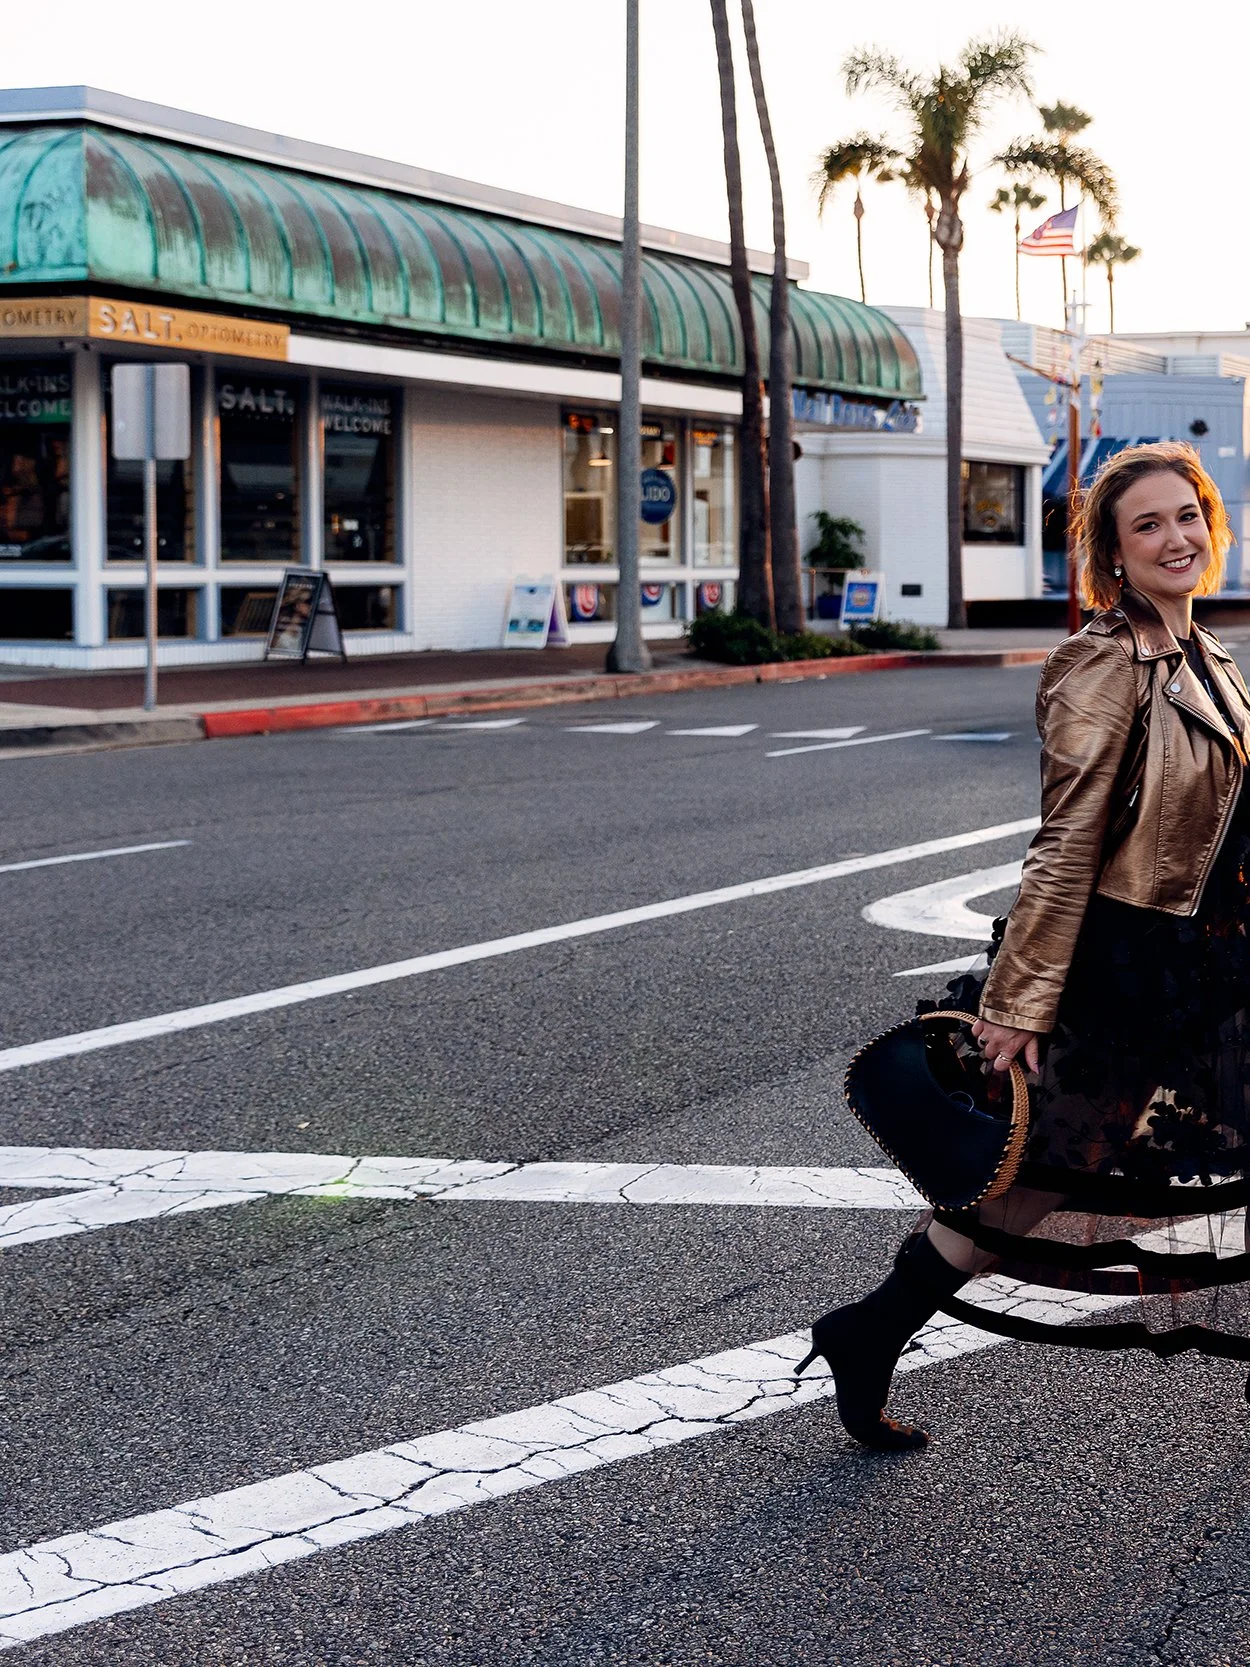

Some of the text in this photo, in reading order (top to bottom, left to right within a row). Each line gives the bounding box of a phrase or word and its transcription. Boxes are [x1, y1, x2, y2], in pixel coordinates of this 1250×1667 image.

[0, 308, 78, 328] OMETRY
[98, 303, 282, 351] SALT. OPTOMETRY
[0, 374, 70, 395] LK-INS
[221, 384, 296, 416] SALT.
[323, 414, 393, 436] WELCOME
